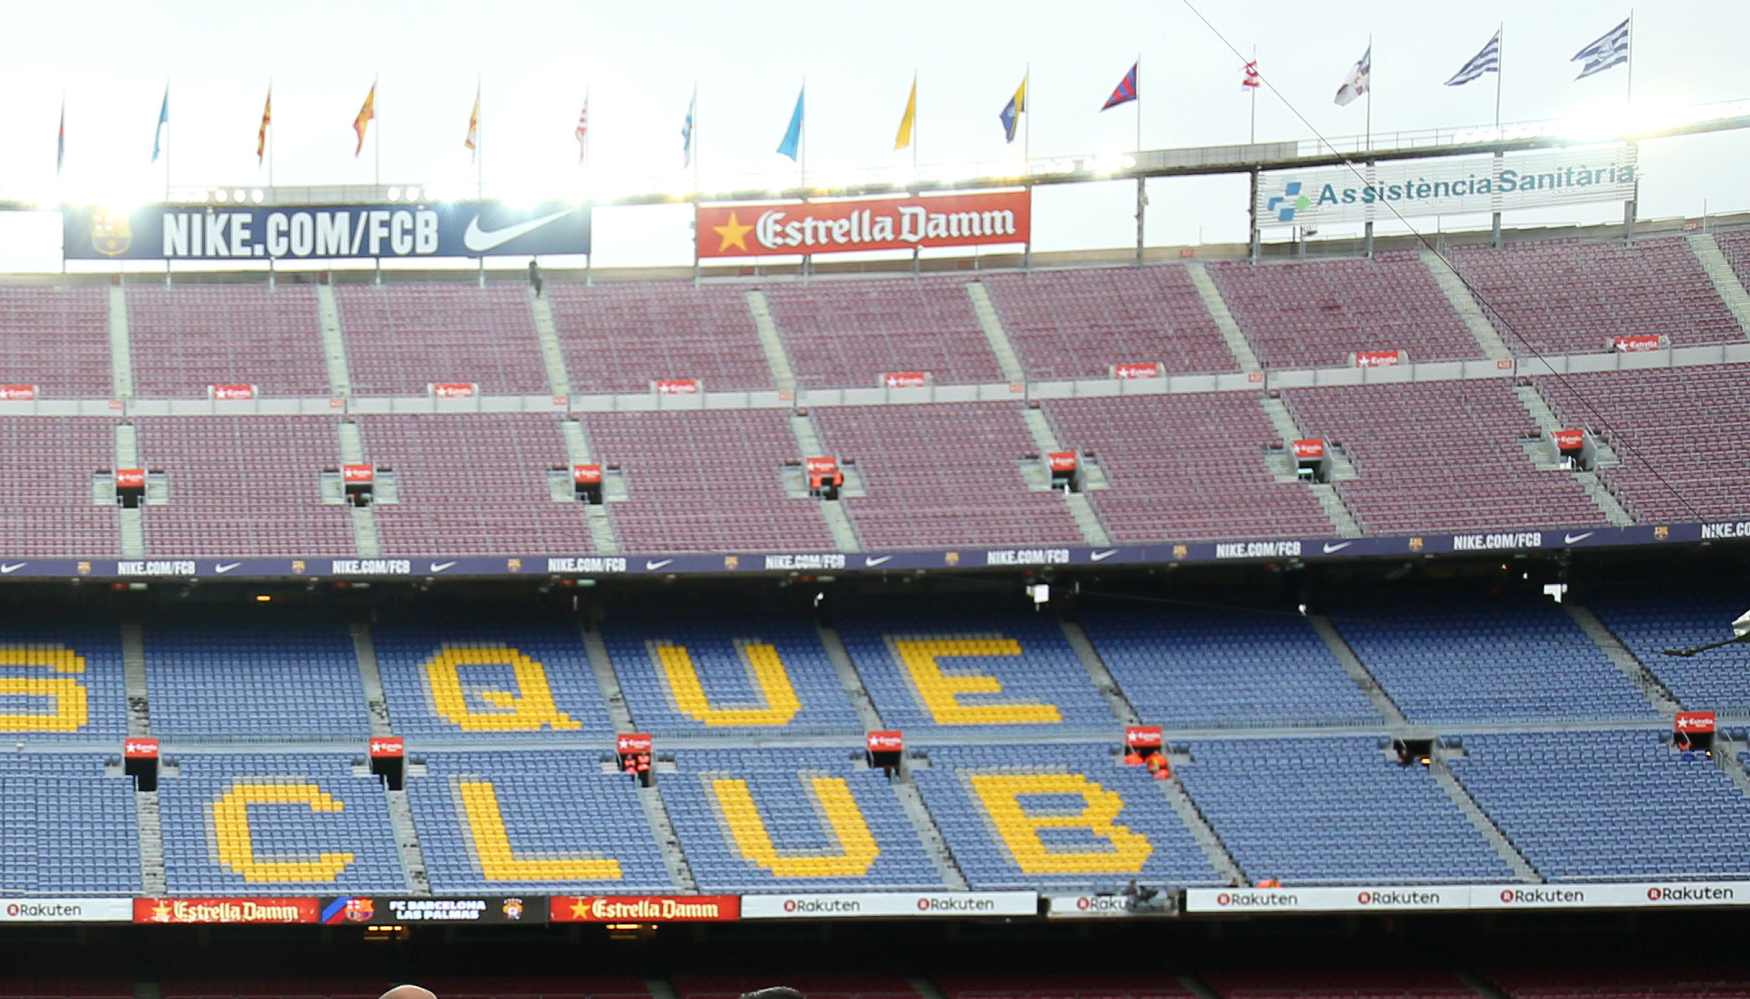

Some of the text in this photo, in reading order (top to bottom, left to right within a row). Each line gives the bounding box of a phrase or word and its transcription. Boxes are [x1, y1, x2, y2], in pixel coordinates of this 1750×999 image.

[1318, 163, 1636, 206] Assistència Sanitària
[162, 209, 440, 258] NIKE.COM/FCB
[755, 205, 1016, 250] Estrella Damm
[1453, 532, 1542, 550] NIKE.COM/FCB
[987, 549, 1070, 564] NIKE.COM/FCB
[1215, 541, 1302, 558] NIKE.COM/FCB
[117, 560, 196, 576] NIKE.COM/FCB
[332, 560, 411, 575] NIKE.COM/FCB
[547, 557, 627, 572] NIKE.COM/FCB
[764, 554, 846, 570] NIKE.COM/FCB
[426, 638, 1062, 731] QUE
[213, 774, 1155, 882] CLUB
[1231, 892, 1298, 907] Rakuten
[1371, 890, 1440, 906] Rakuten
[1514, 887, 1585, 903] Rakuten
[1661, 884, 1734, 902] Rakuten
[20, 902, 82, 917] Rakuten
[173, 900, 299, 922] Estrella Damm
[407, 900, 487, 911] BARCELONA
[592, 899, 719, 919] Estrella Damm
[797, 897, 861, 912] Rakuten
[931, 896, 995, 911] Rakuten
[396, 910, 480, 920] LAS PALMAS
